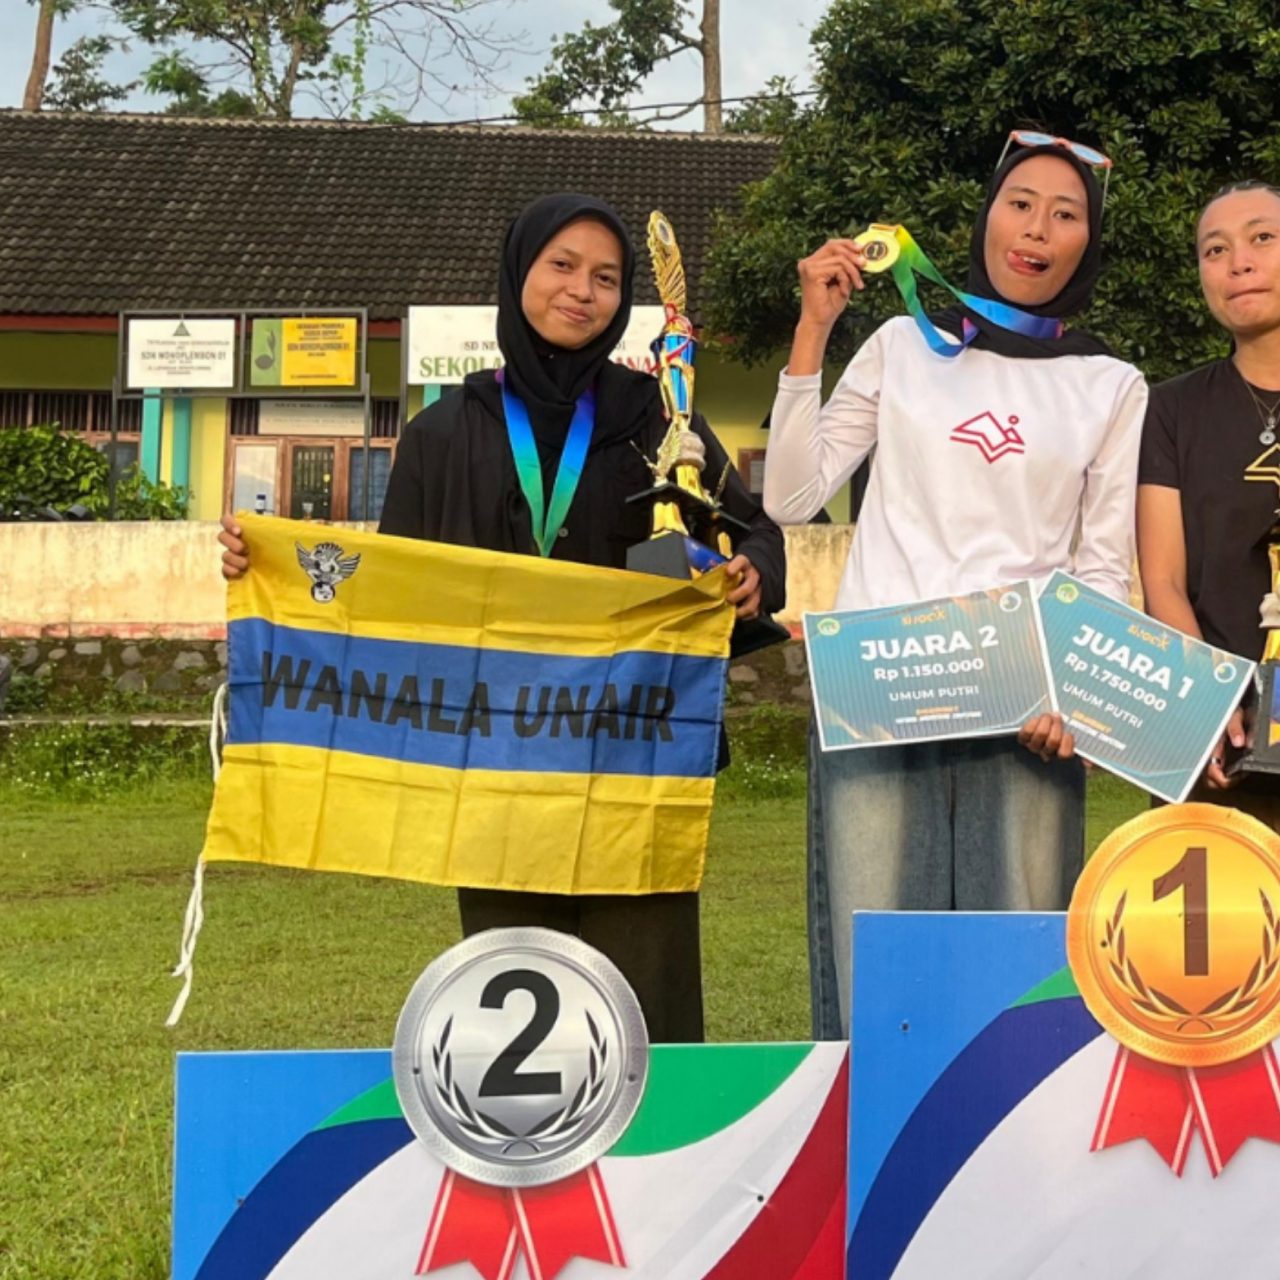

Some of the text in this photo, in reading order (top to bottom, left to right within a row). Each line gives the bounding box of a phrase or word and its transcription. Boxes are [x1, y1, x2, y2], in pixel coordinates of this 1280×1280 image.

[420, 356, 505, 377] SEKOLA
[860, 625, 999, 661] JUARA 2
[1072, 624, 1171, 691] JUARA
[1178, 676, 1194, 699] 1
[874, 658, 984, 682] Rp 1.150.000
[889, 685, 979, 701] UMUM PUTRI
[1064, 652, 1167, 712] Rp 1.750.000
[262, 652, 676, 742] WANALA UNAIR
[1062, 682, 1144, 728] UMUM PUTRI
[1153, 847, 1209, 976] 1
[478, 968, 562, 1097] 2
